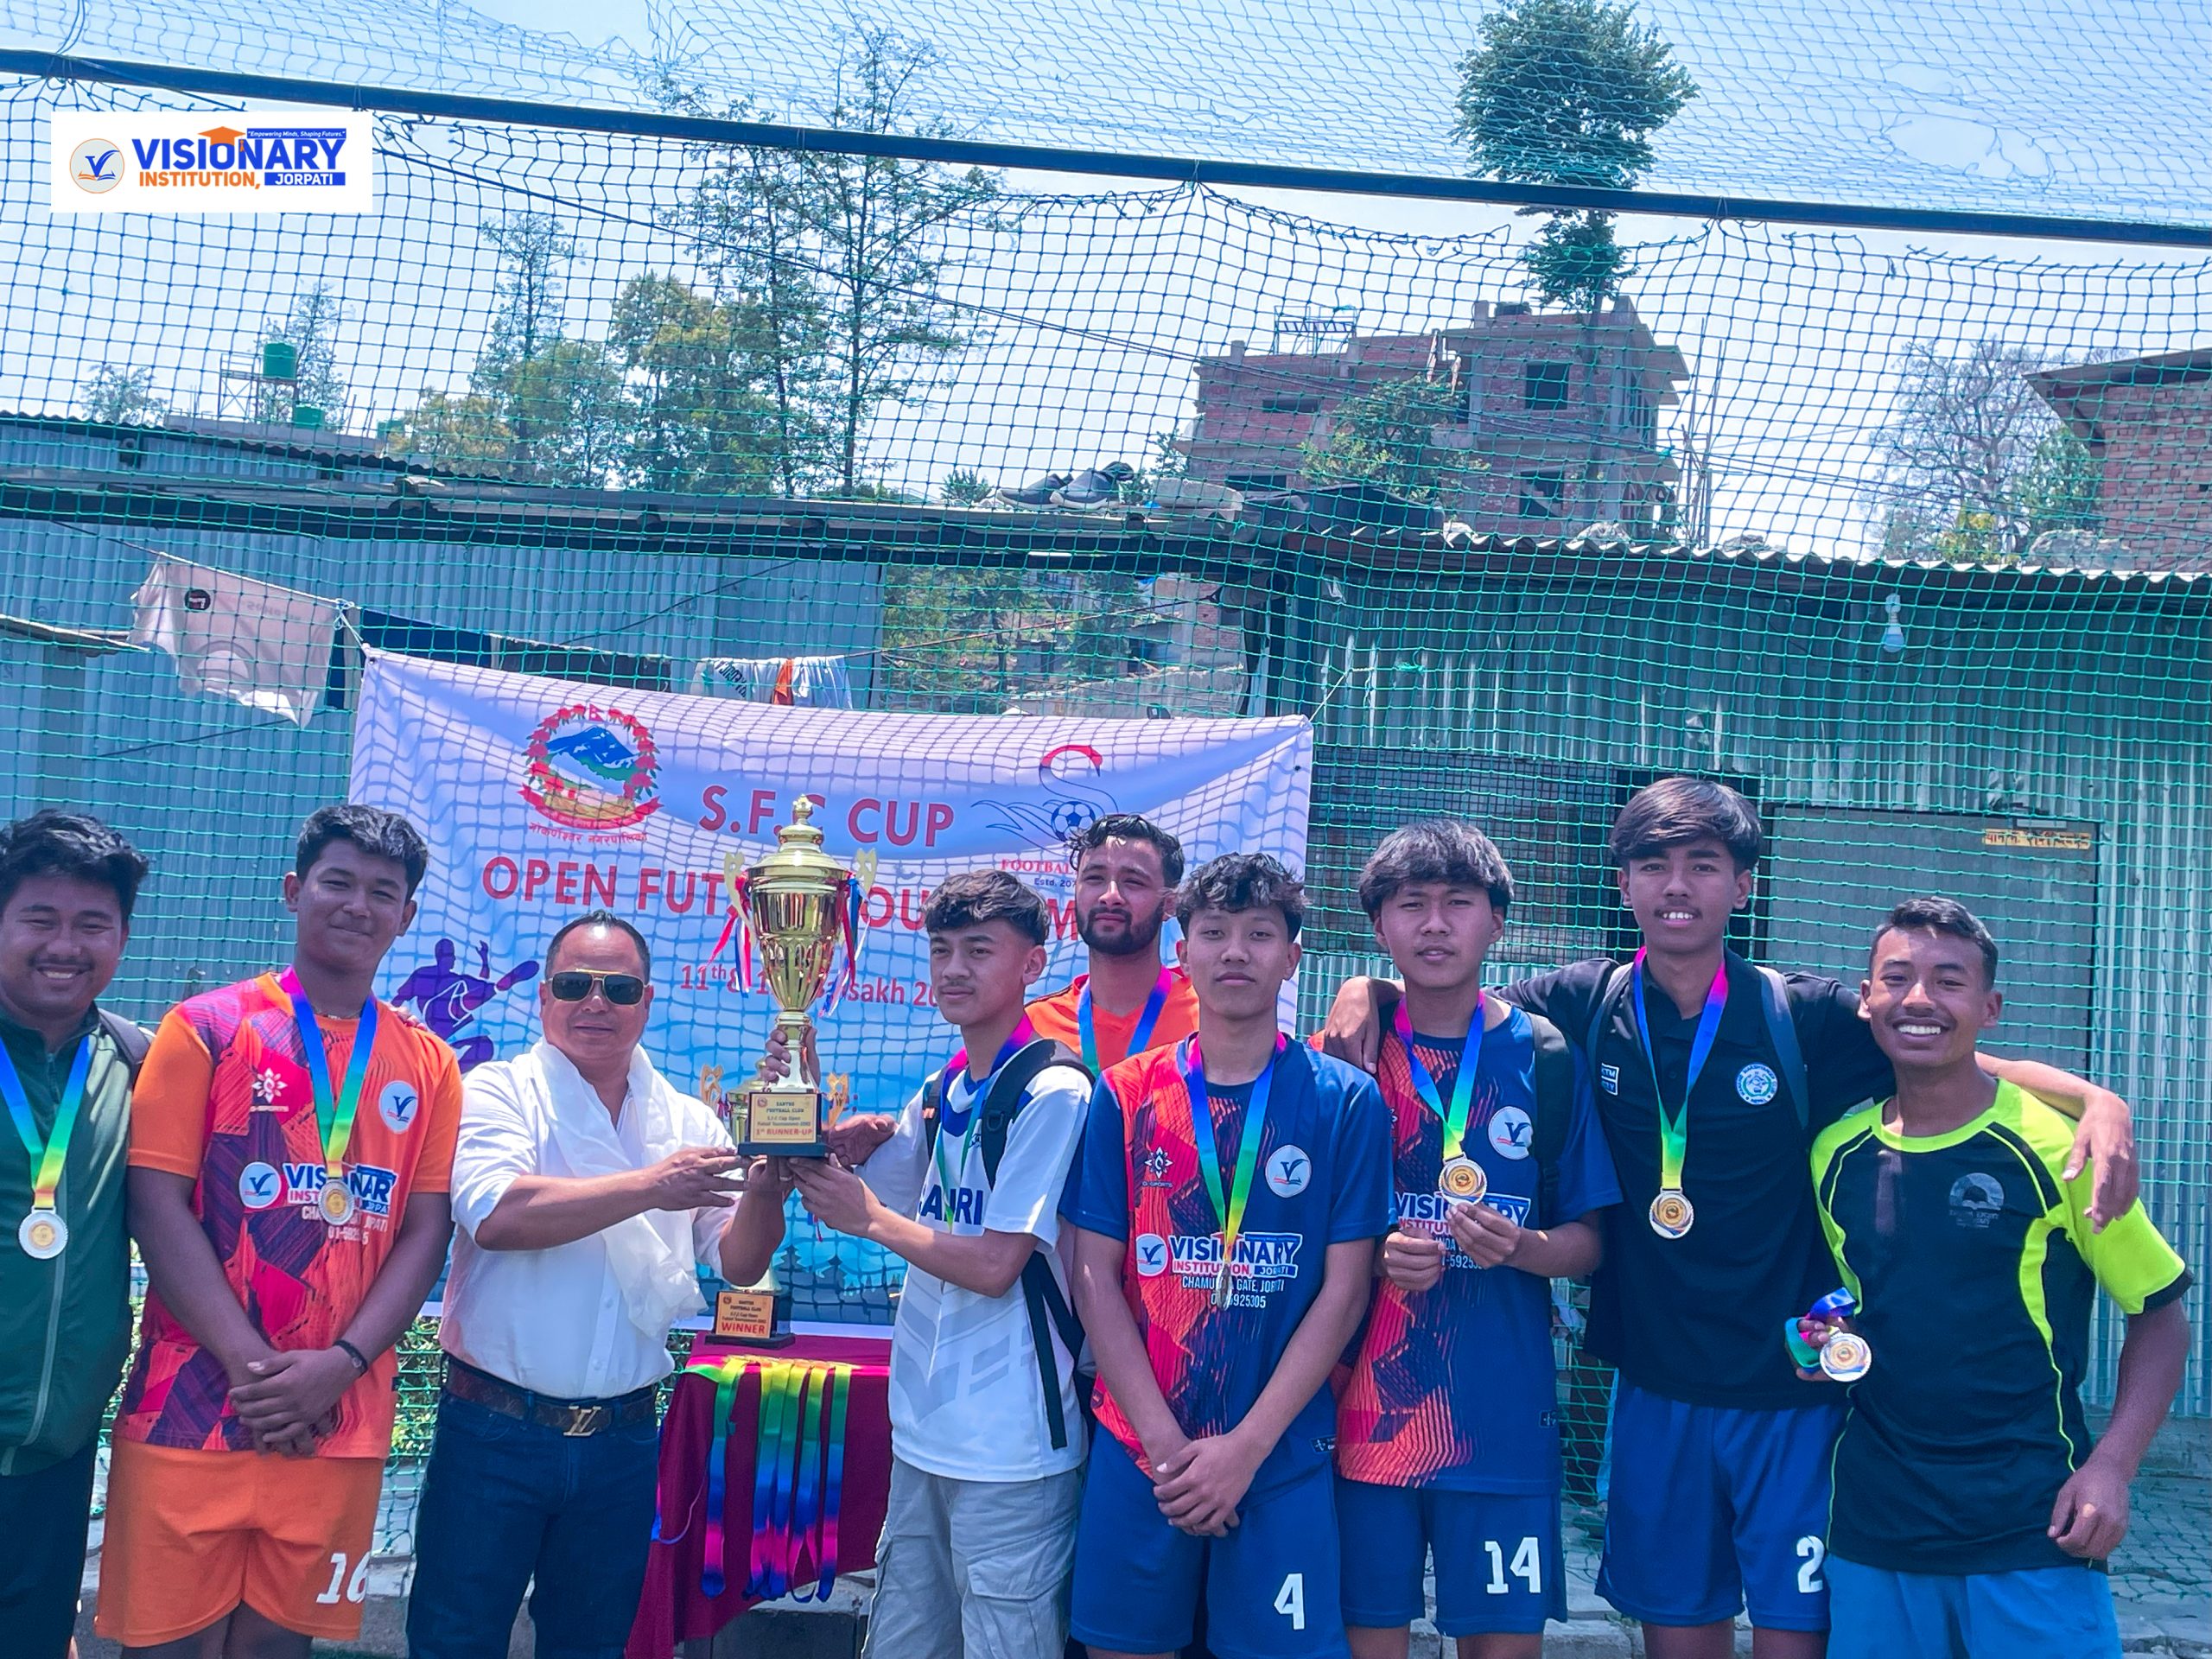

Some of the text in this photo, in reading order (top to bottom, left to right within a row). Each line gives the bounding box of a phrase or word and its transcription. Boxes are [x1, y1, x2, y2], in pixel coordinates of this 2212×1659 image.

[848, 798, 954, 847] CUP
[482, 856, 617, 907] OPEN
[1173, 1261, 1253, 1278] INSTITUON,
[721, 1321, 766, 1335] WINNER
[1484, 1536, 1541, 1594] 14
[1273, 1573, 1306, 1630] 4
